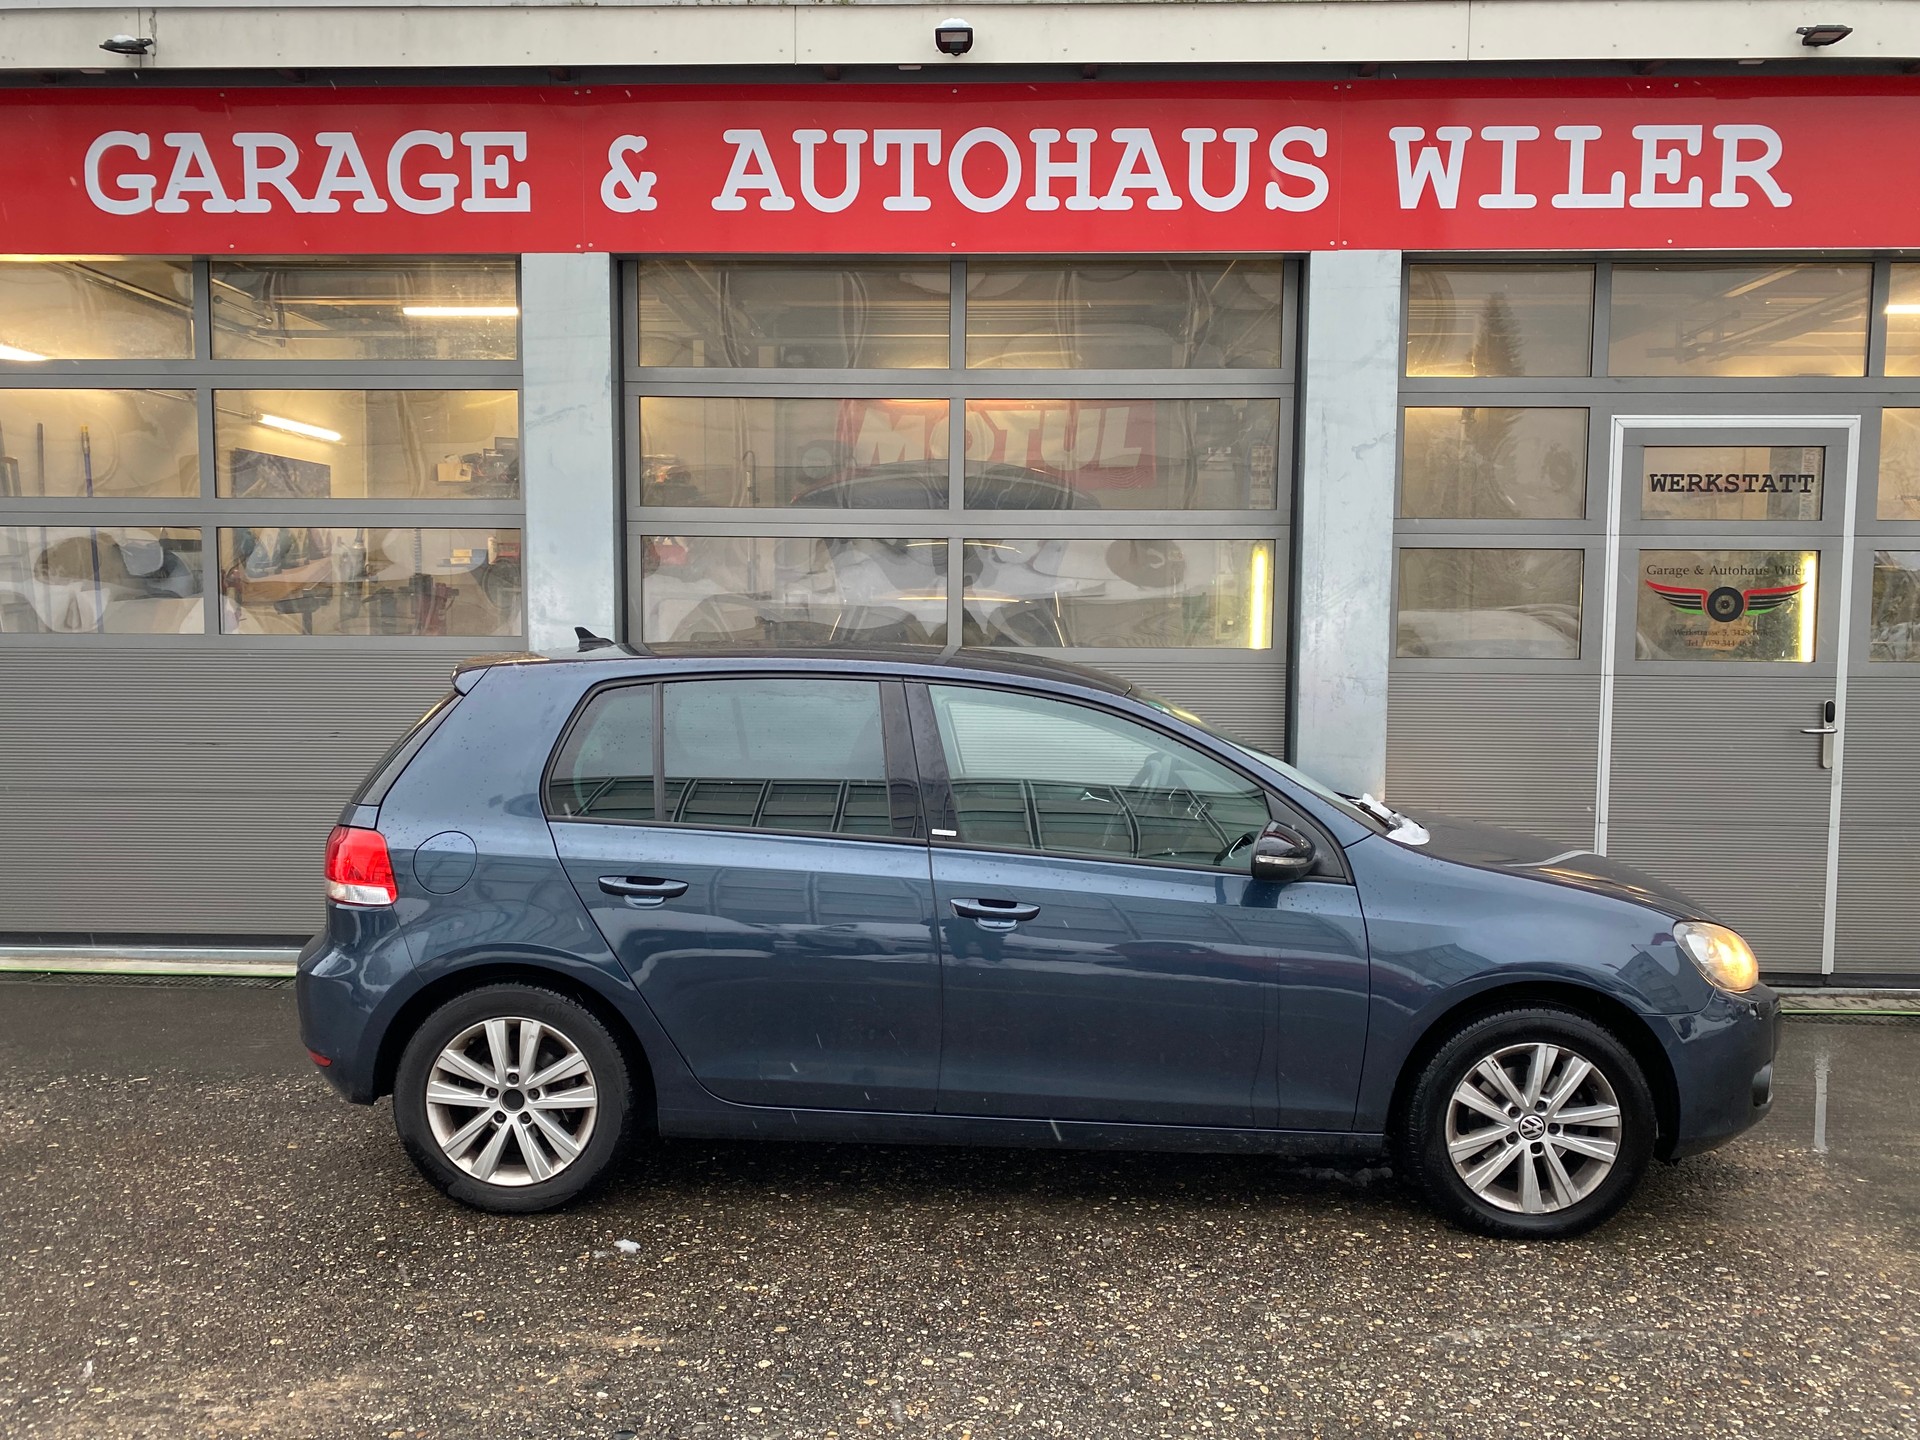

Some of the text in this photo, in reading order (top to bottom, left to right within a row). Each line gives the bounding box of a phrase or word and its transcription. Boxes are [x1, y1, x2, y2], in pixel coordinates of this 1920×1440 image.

[85, 125, 1792, 215] GARAGE & AUTOHAUS WILER
[853, 404, 1142, 470] MOTUL
[1649, 473, 1815, 493] WERKSTATT
[1646, 564, 1807, 578] Garage & Autohaus Wiler
